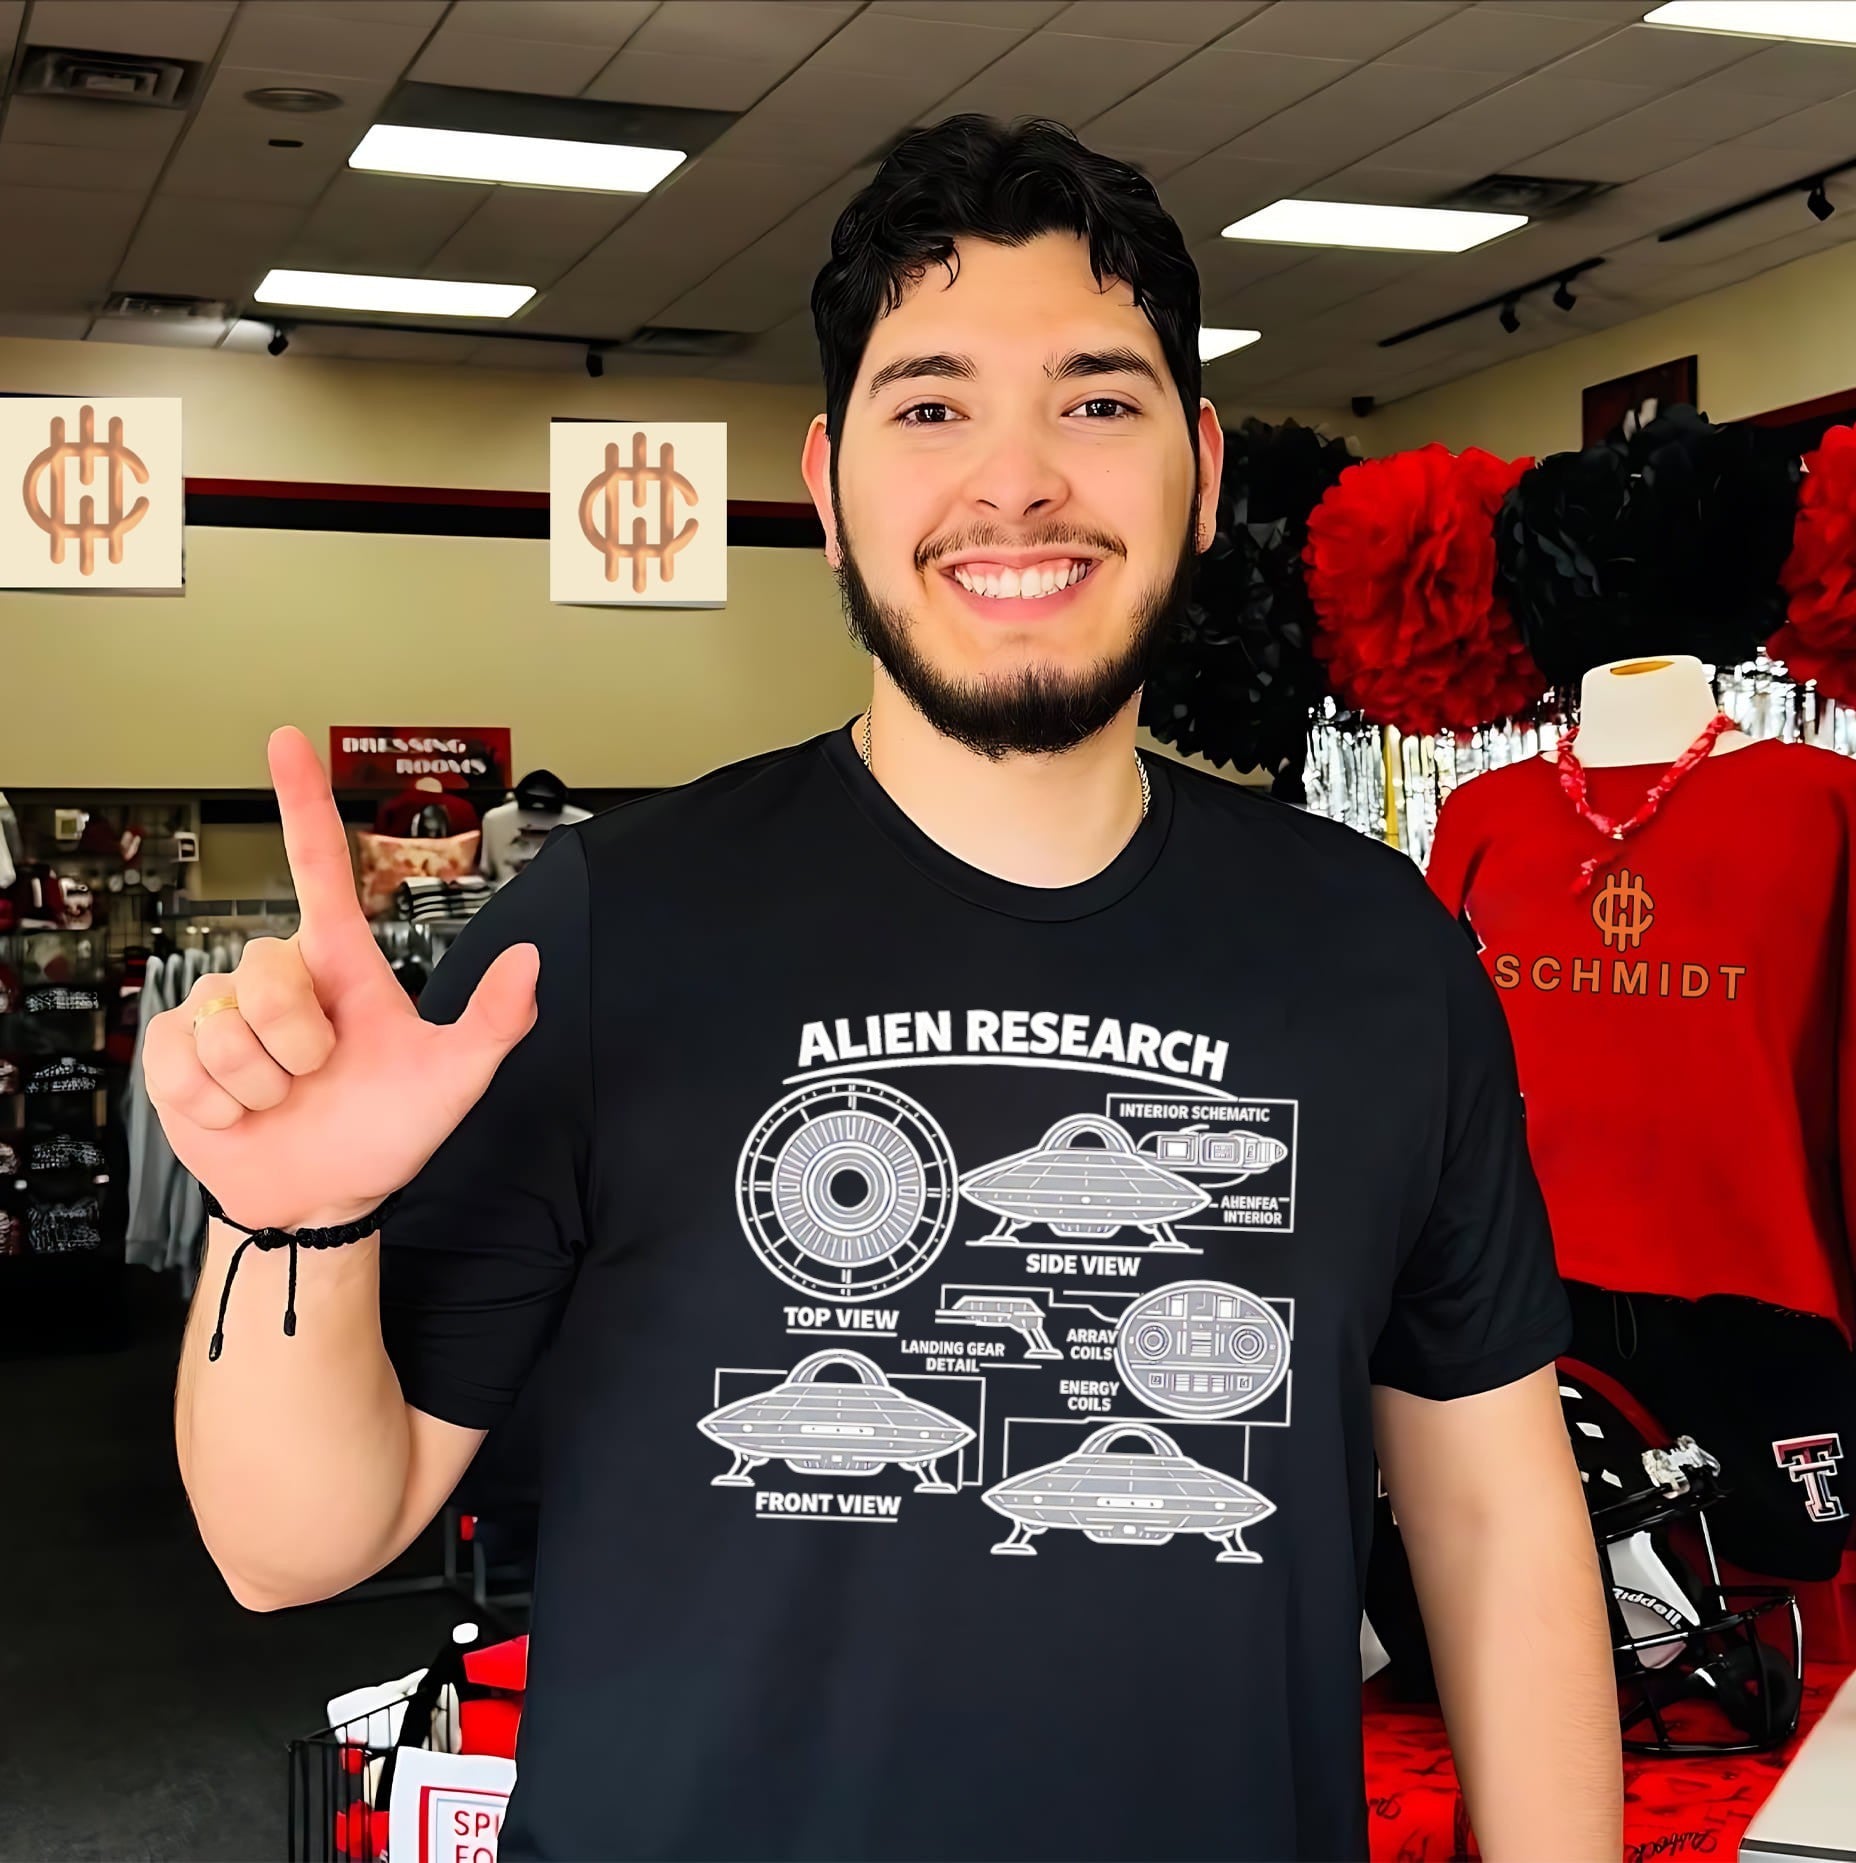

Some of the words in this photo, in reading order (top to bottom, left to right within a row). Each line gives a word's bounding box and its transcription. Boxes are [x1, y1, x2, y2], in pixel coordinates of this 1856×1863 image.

[342, 737, 467, 754] DRESSING
[396, 758, 487, 774] ROOMS
[1494, 954, 1747, 1000] SCHMIDT
[798, 1010, 953, 1067] ALIEN
[965, 1010, 1230, 1081] RESEARCH
[1119, 1103, 1189, 1119] INTERIOR
[1191, 1105, 1271, 1122] SCHEMATIC
[1223, 1210, 1283, 1225] INTERIOR
[1026, 1253, 1078, 1275] SIDE
[1082, 1256, 1141, 1277] VIEW
[784, 1306, 831, 1328] TOP
[835, 1308, 900, 1331] VIEW
[1066, 1328, 1119, 1345] ARRAY
[901, 1340, 964, 1356] LANDING
[966, 1342, 1006, 1357] GEAR
[1070, 1346, 1114, 1361] COILS
[926, 1357, 981, 1373] DETAIL
[1059, 1380, 1120, 1397] ENERGY
[1067, 1397, 1112, 1412] COILS
[755, 1492, 830, 1515] FRONT
[833, 1494, 902, 1516] VIEW
